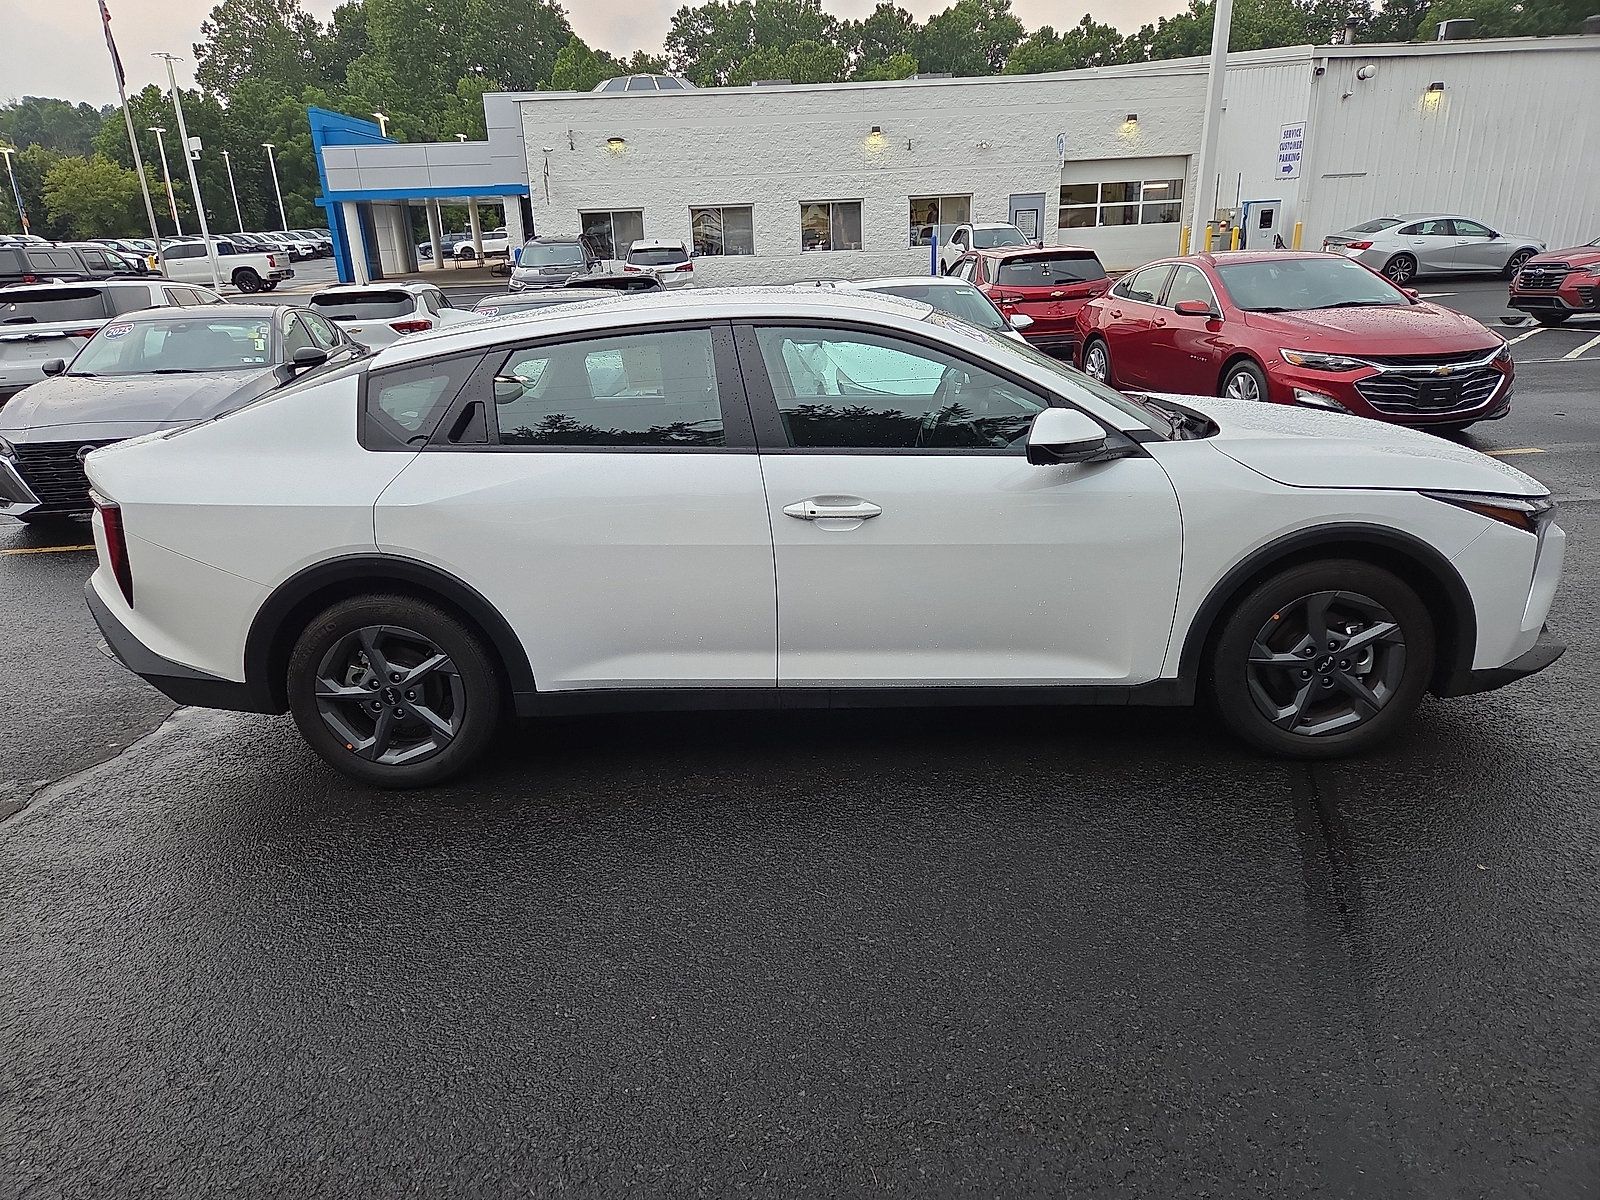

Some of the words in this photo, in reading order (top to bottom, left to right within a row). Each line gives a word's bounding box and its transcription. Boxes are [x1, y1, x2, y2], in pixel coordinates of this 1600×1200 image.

[1282, 128, 1302, 139] SERVICE
[1279, 140, 1302, 151] CUSTOMER
[1278, 152, 1300, 163] PARKING
